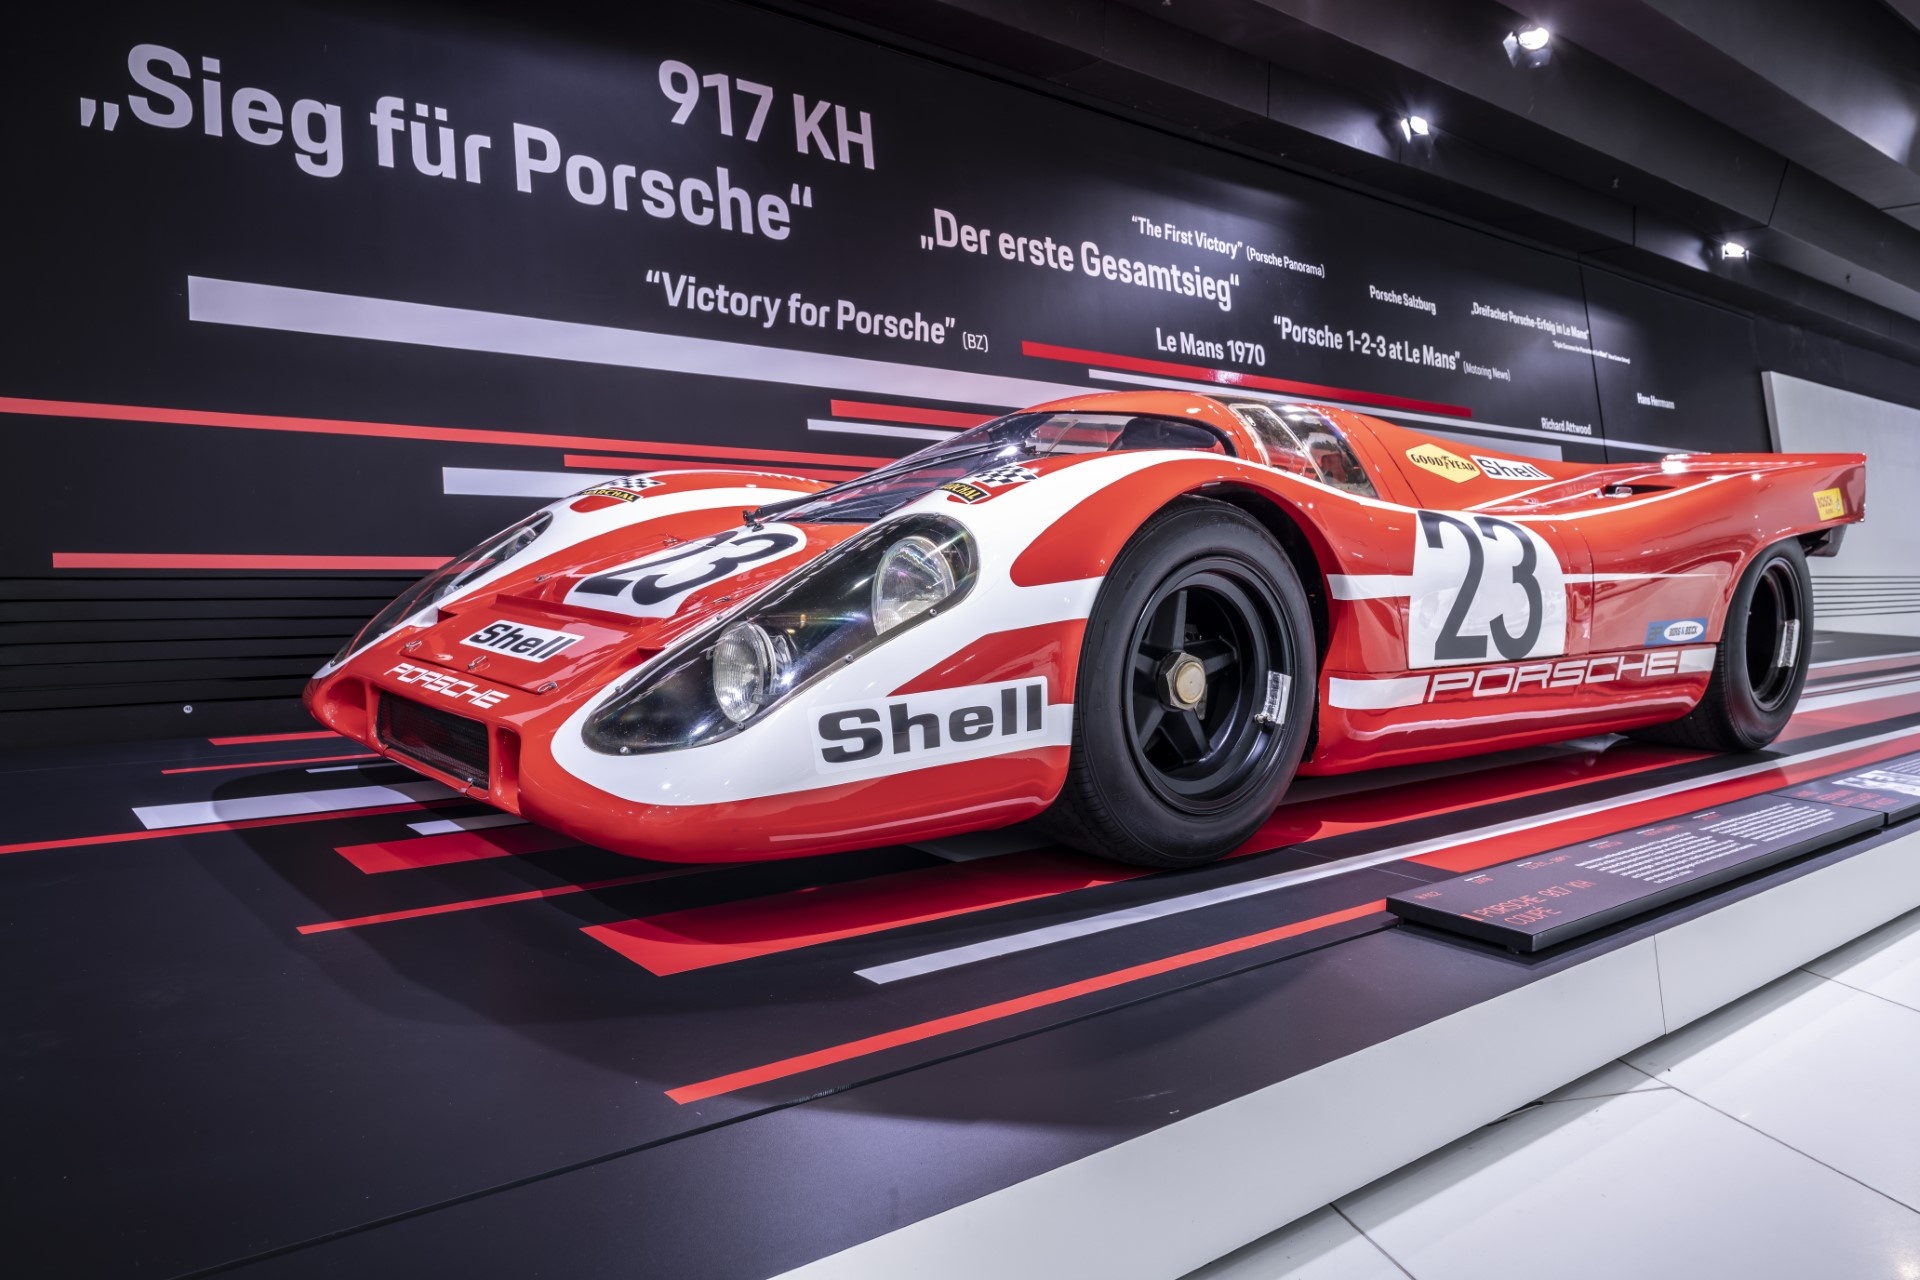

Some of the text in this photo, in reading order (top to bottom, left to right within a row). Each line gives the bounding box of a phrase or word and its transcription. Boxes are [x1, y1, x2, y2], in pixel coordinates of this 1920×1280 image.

[658, 59, 875, 170] 917 KH
[370, 95, 492, 185] für
[998, 232, 1075, 273] erste
[1164, 223, 1194, 246] First
[1246, 245, 1283, 268] (Porsche
[1283, 255, 1326, 279] Panorama)
[787, 292, 831, 328] for
[962, 331, 989, 354] (BZ)
[1369, 284, 1437, 316] Porsche Salzburg
[1155, 326, 1267, 367] Le Mans 1970
[1555, 321, 1563, 335] in
[1562, 323, 1571, 337] Le
[1346, 329, 1387, 358] 1-2-3
[1388, 341, 1403, 361] at
[1404, 340, 1421, 364] Le
[1463, 360, 1492, 380] (Motoring
[1492, 367, 1511, 382] News)
[1541, 416, 1592, 436] Richard Attwood
[1476, 458, 1548, 478] Shell
[573, 530, 799, 606] 23
[1418, 509, 1544, 661] 23
[468, 622, 577, 659] Shell
[383, 662, 511, 710] PORSCHE
[1427, 650, 1680, 703] PORSCHE
[817, 683, 1043, 764] Shell
[1472, 894, 1547, 918] PORSCHE
[1537, 885, 1573, 899] 917
[1503, 904, 1563, 927] COUPÉ
